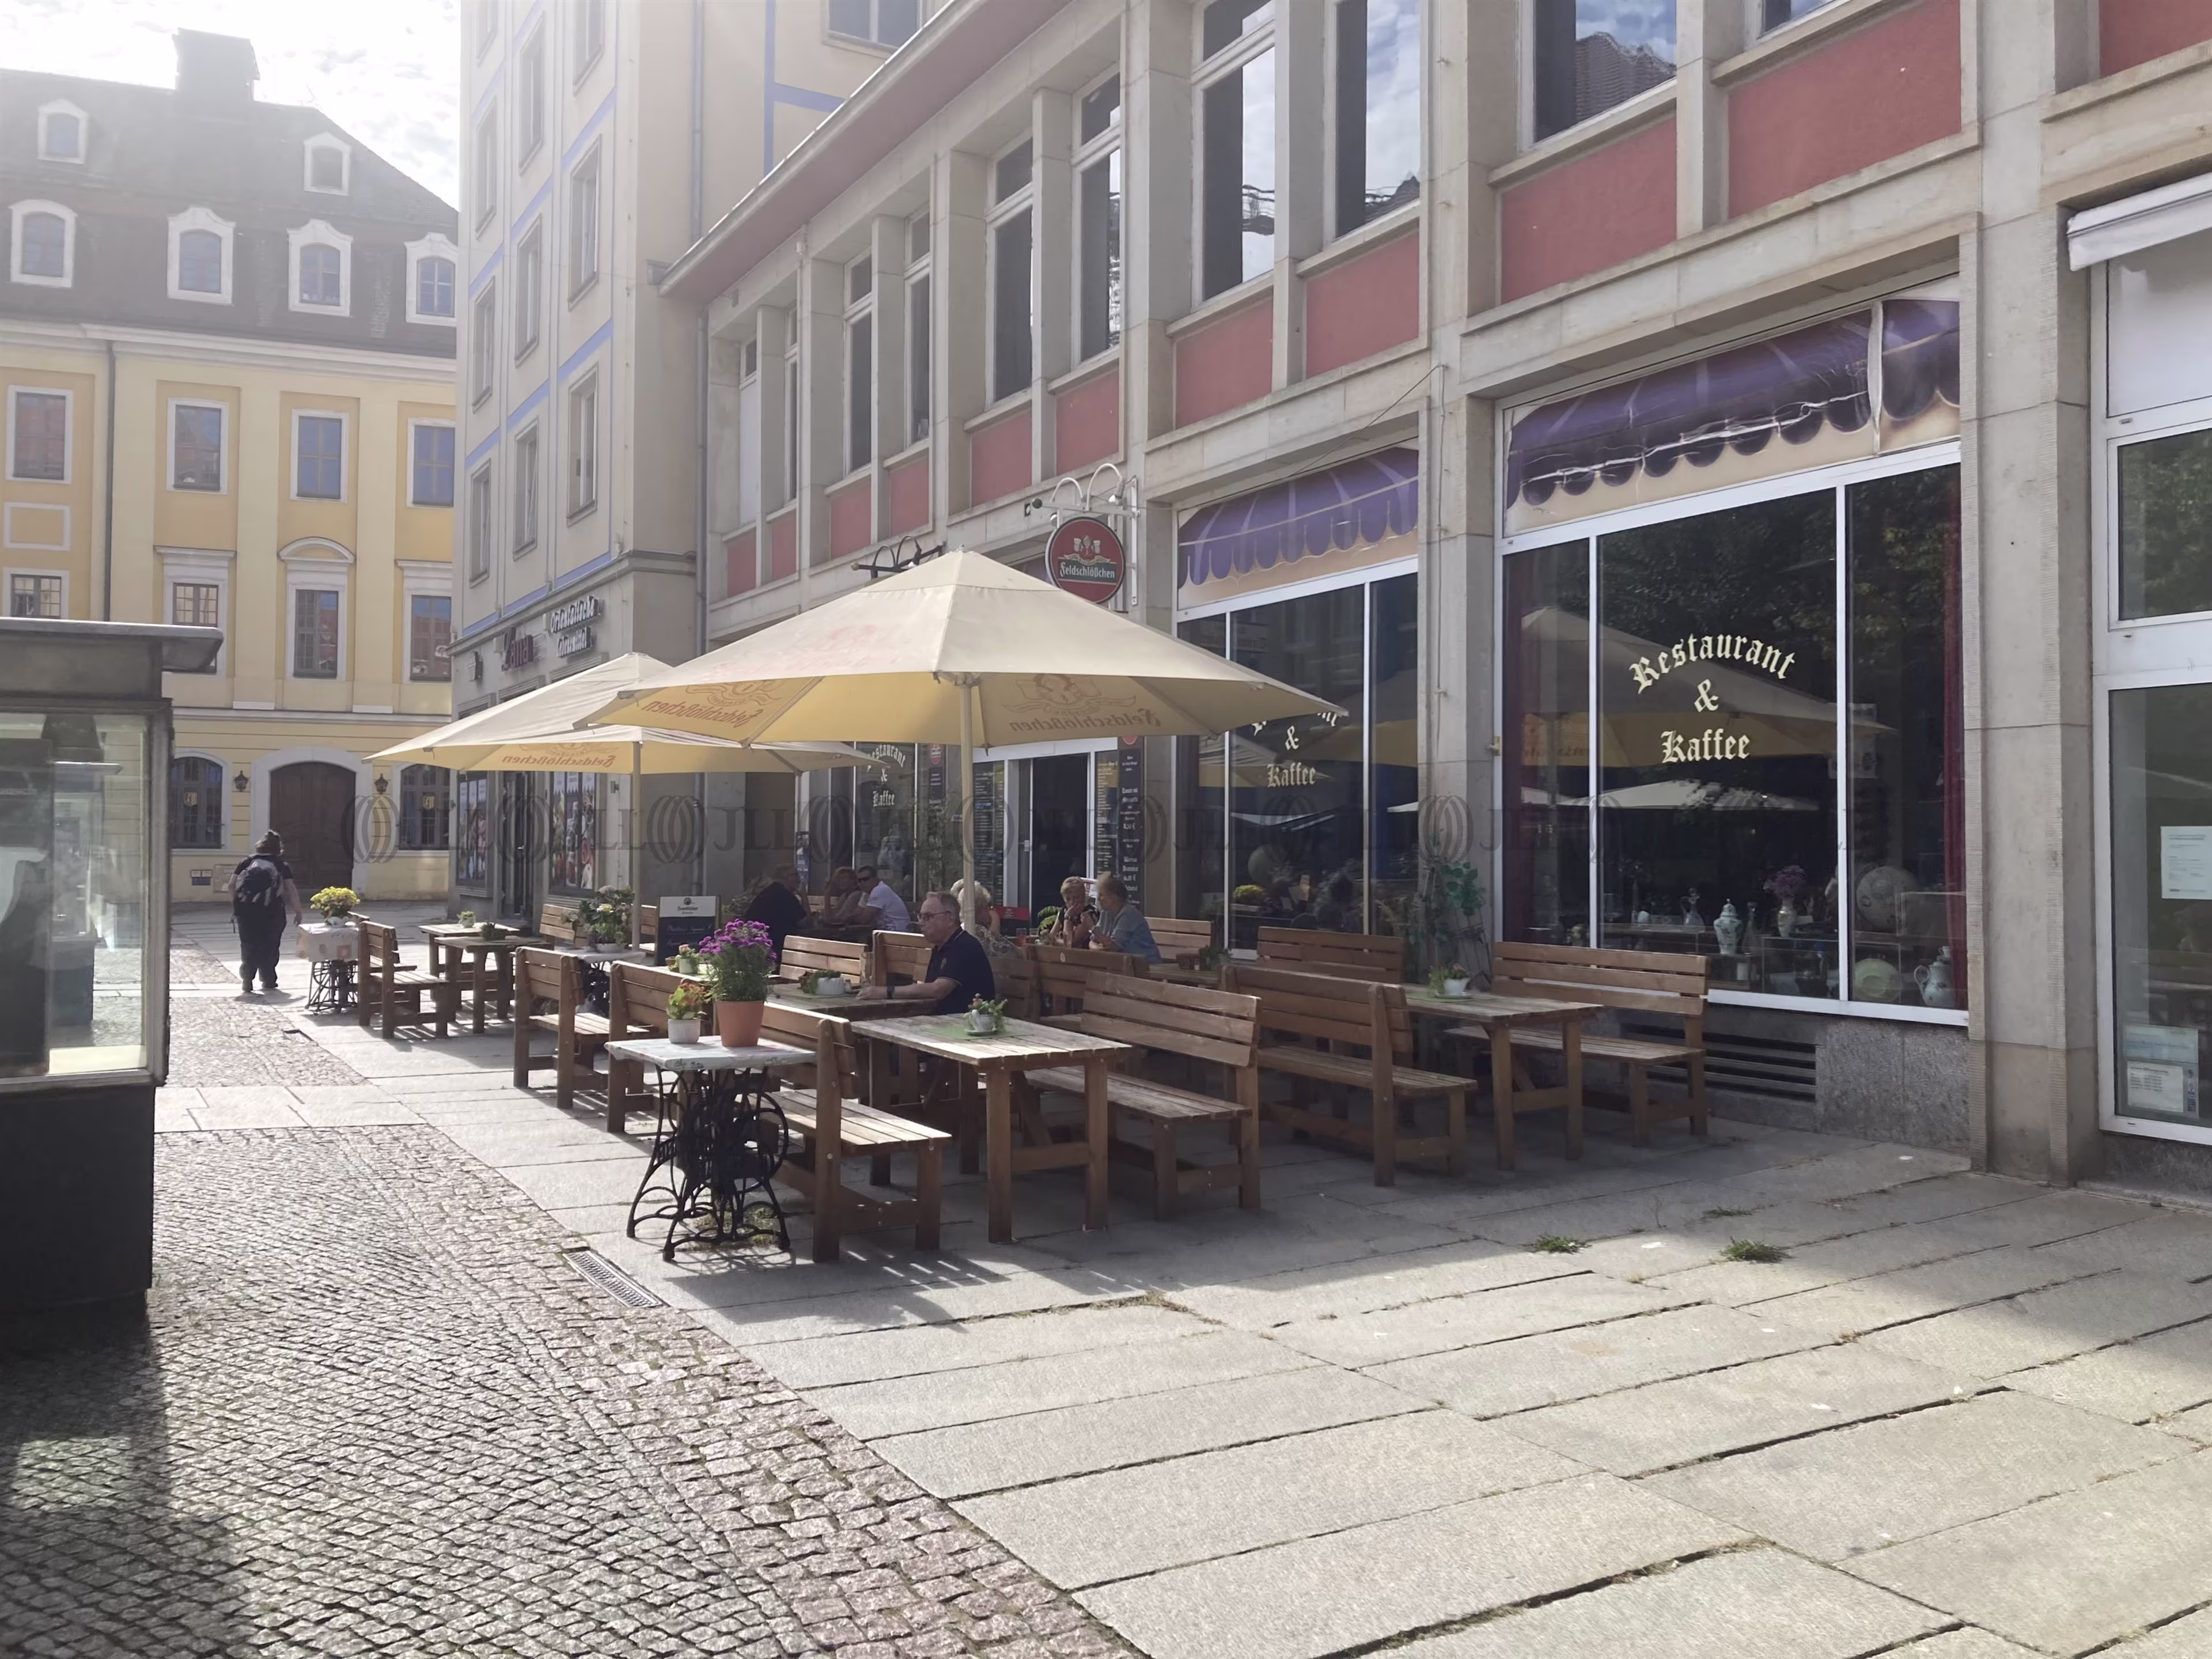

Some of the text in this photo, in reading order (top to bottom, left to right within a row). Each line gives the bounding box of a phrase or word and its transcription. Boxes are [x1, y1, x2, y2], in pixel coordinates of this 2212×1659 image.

[1060, 562, 1115, 578] Feldschlößchen
[1629, 633, 1796, 694] Restaurant
[1694, 679, 1719, 713] &
[1285, 725, 1300, 750] &
[1660, 728, 1751, 764] Kaffee
[867, 743, 906, 772] estaurant
[880, 767, 888, 782] &
[1267, 762, 1317, 788] Kaffee
